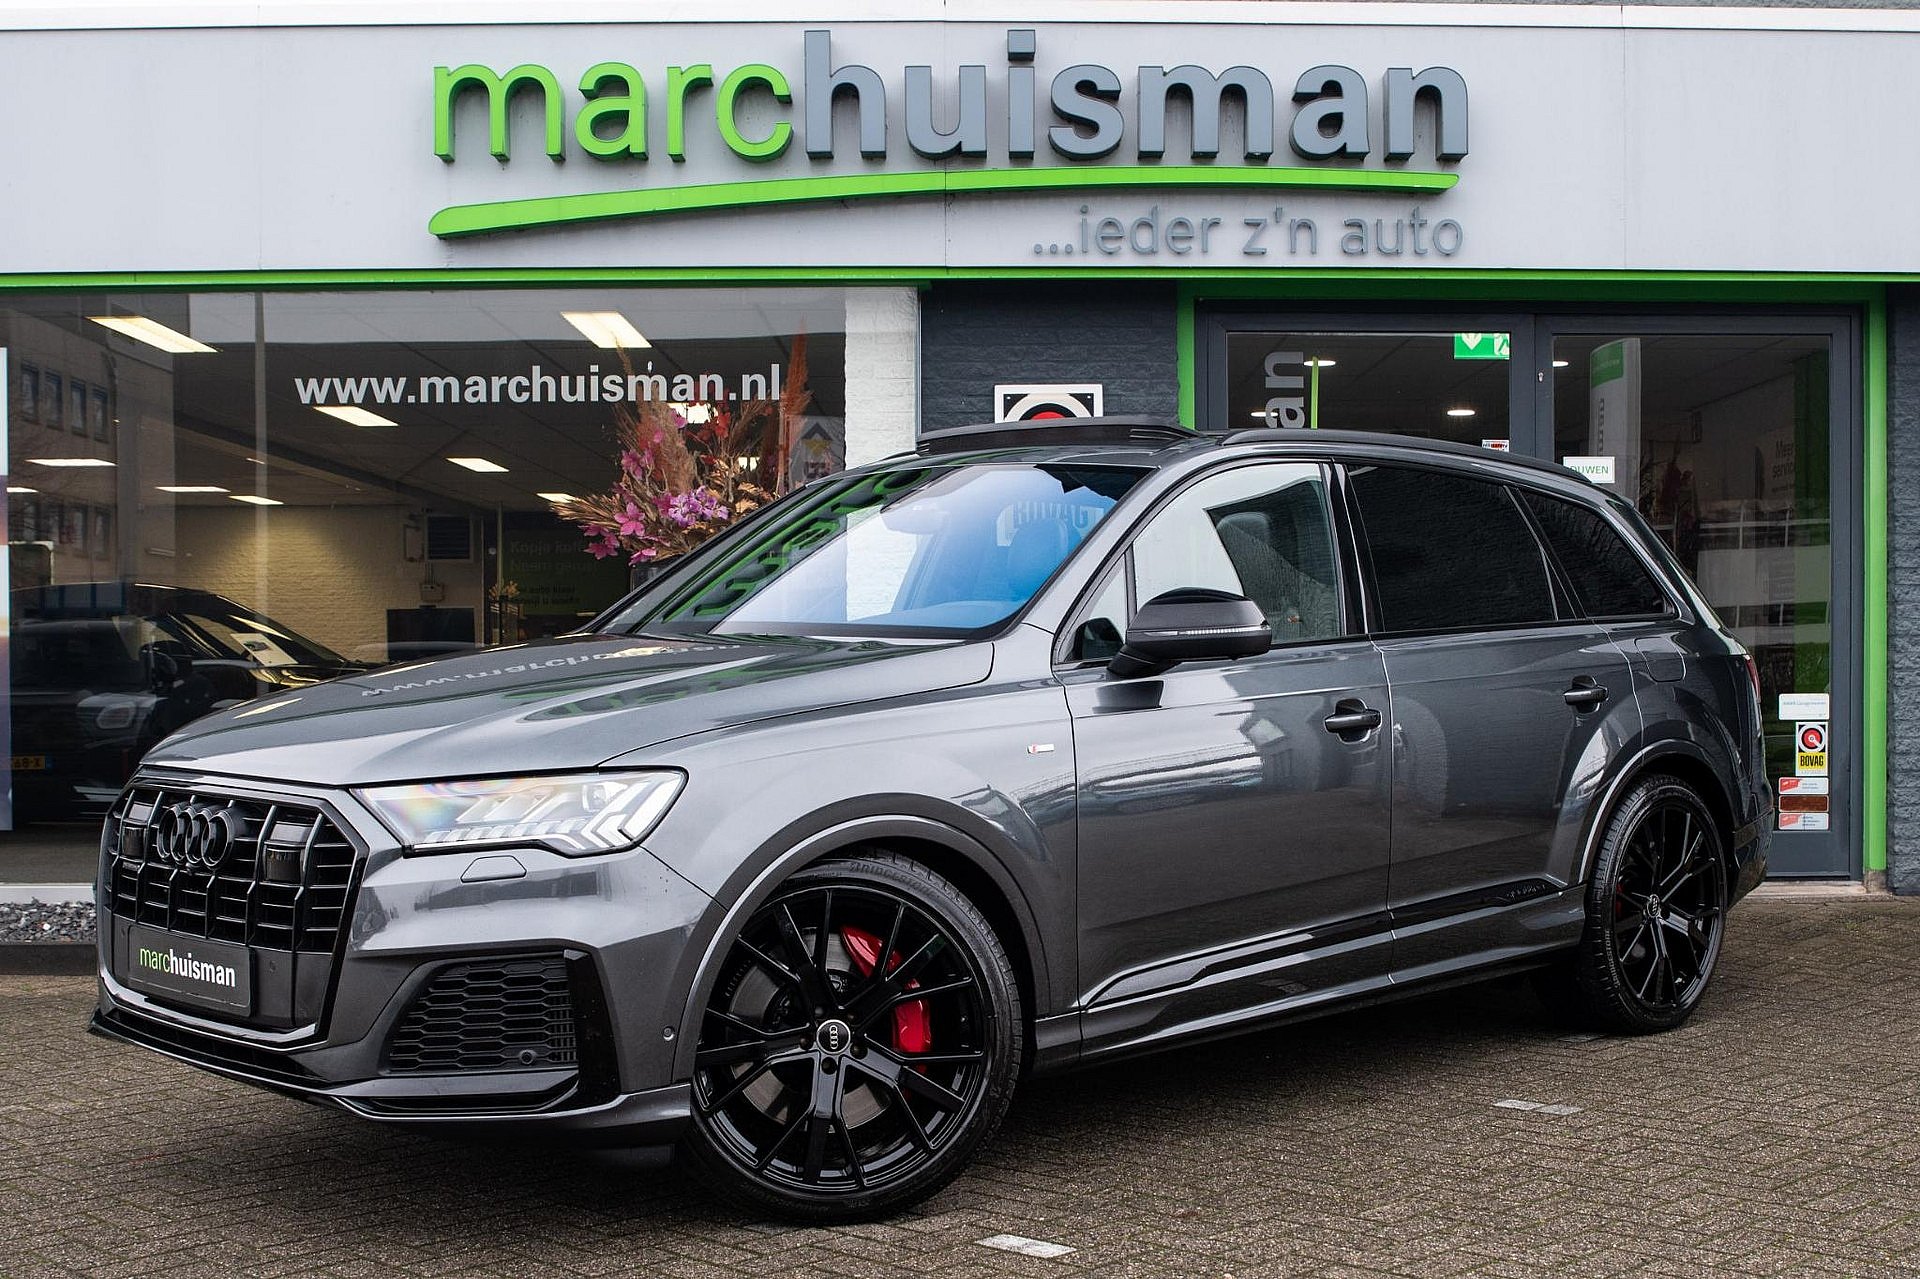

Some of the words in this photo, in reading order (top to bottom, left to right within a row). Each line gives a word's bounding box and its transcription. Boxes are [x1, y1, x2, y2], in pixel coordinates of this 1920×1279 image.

[433, 29, 1469, 163] marchuisman
[1242, 205, 1317, 255] z'n
[1340, 206, 1464, 256] auto
[294, 363, 781, 404] www.marchuisman.nl
[1800, 756, 1824, 767] BOVAG
[140, 948, 236, 988] marchuisman
